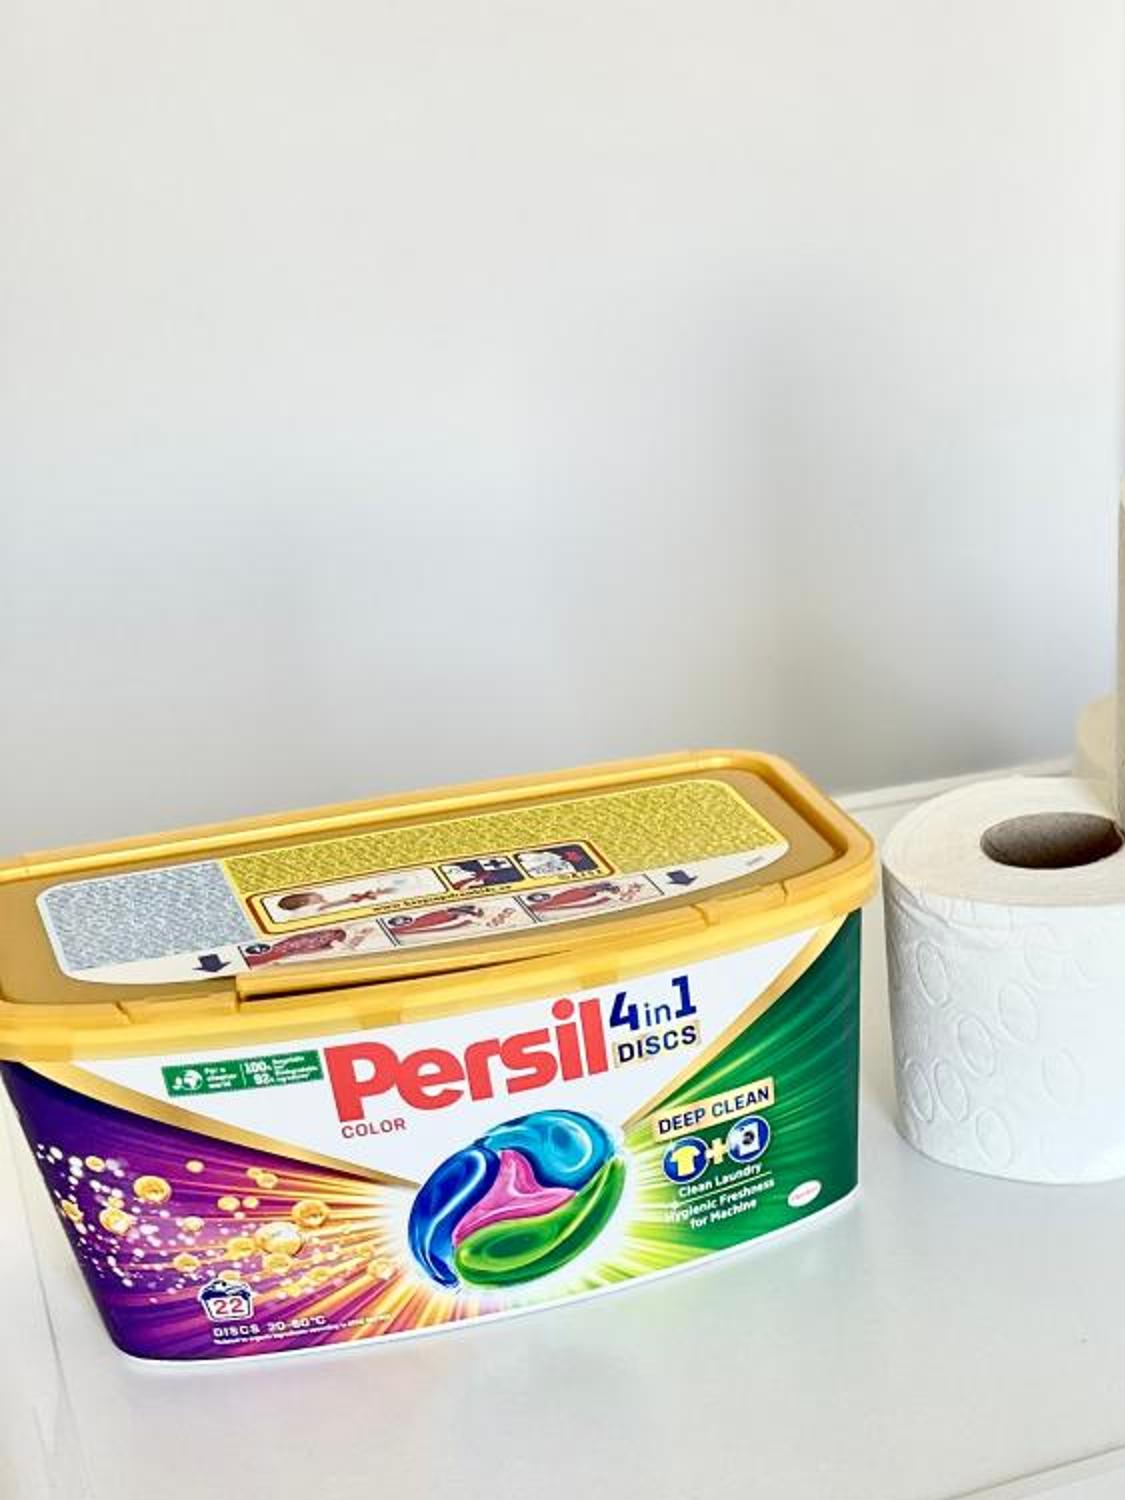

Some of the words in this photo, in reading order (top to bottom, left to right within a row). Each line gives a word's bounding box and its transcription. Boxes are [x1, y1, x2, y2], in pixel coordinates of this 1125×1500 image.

[323, 998, 608, 1122] Persil
[617, 1024, 697, 1063] DISCS
[341, 1117, 406, 1140] COLOR
[658, 1107, 706, 1135] DEEP
[711, 1086, 770, 1118] CLEAN
[678, 1177, 713, 1198] Clean
[715, 1162, 763, 1187] Laundry
[665, 1198, 718, 1226] Hygienic
[719, 1178, 775, 1207] Freshness
[689, 1213, 708, 1230] for
[710, 1199, 758, 1223] Machine
[213, 1297, 244, 1315] 22
[213, 1323, 261, 1338] DISCS
